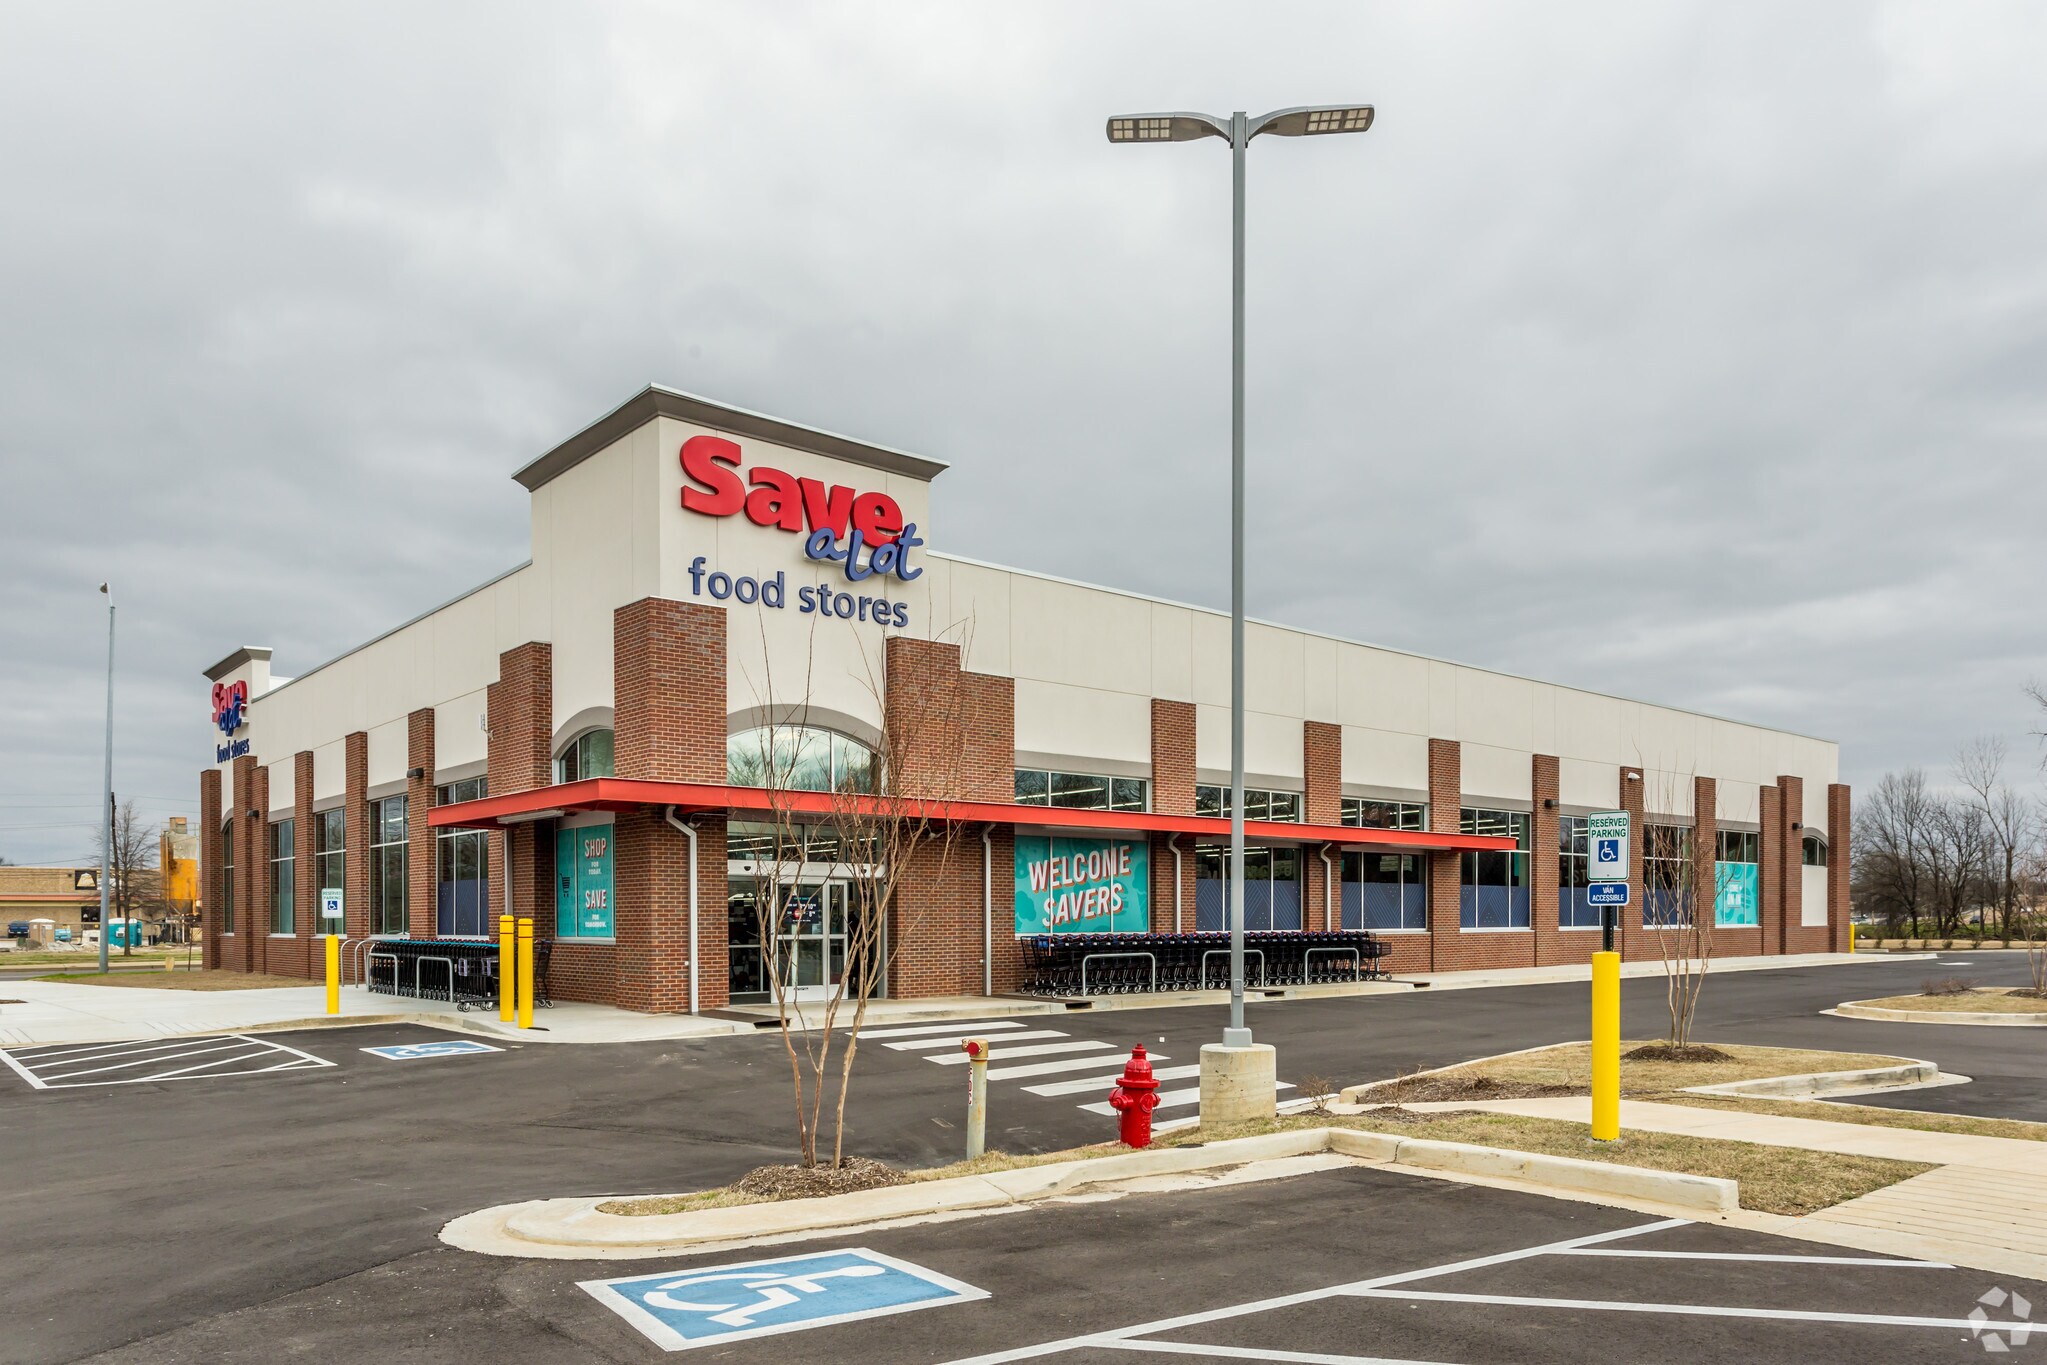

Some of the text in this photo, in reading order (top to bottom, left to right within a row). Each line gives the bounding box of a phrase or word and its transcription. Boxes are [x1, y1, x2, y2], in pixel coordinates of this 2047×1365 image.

[679, 435, 903, 549] Save
[688, 556, 909, 628] food stores
[212, 680, 248, 723] Save
[1590, 818, 1628, 828] RESERVED
[1591, 829, 1627, 838] PARKING
[584, 838, 607, 858] SHOP
[1028, 845, 1132, 893] WELCOME
[585, 890, 607, 909] SAVE
[1592, 894, 1625, 902] ACCESSIBLE
[1602, 886, 1614, 894] VAN
[1042, 883, 1125, 929] SAVERS
